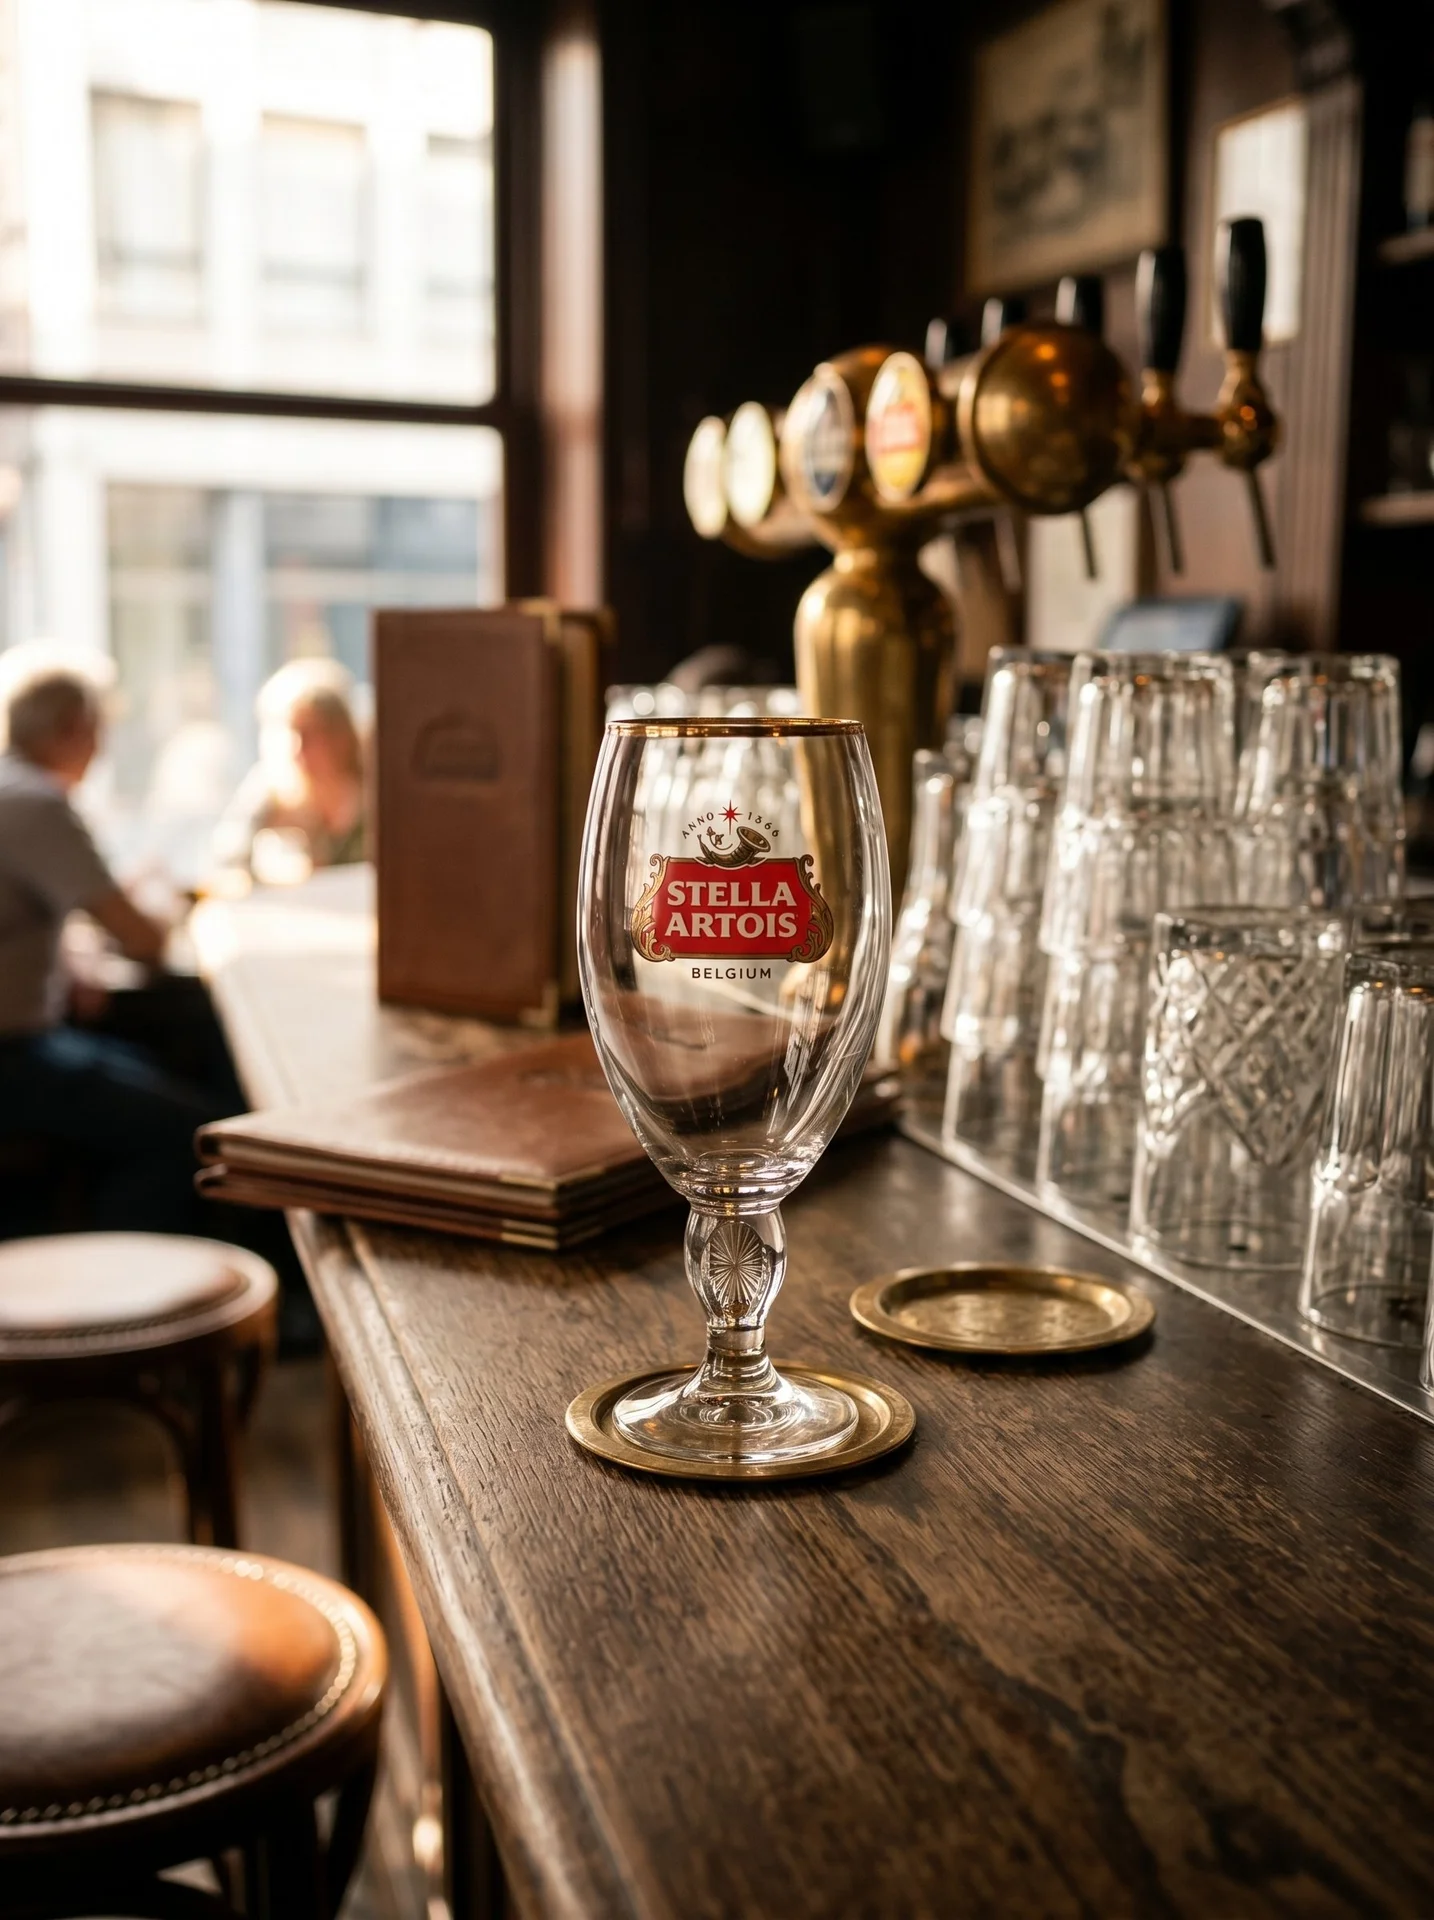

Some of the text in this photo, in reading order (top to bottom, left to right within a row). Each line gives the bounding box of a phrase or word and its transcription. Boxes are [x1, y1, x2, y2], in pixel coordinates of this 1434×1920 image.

[682, 811, 714, 839] ANNO
[667, 881, 798, 907] STELLA
[665, 912, 798, 938] ARTOIS
[692, 967, 772, 979] BELGIUM
